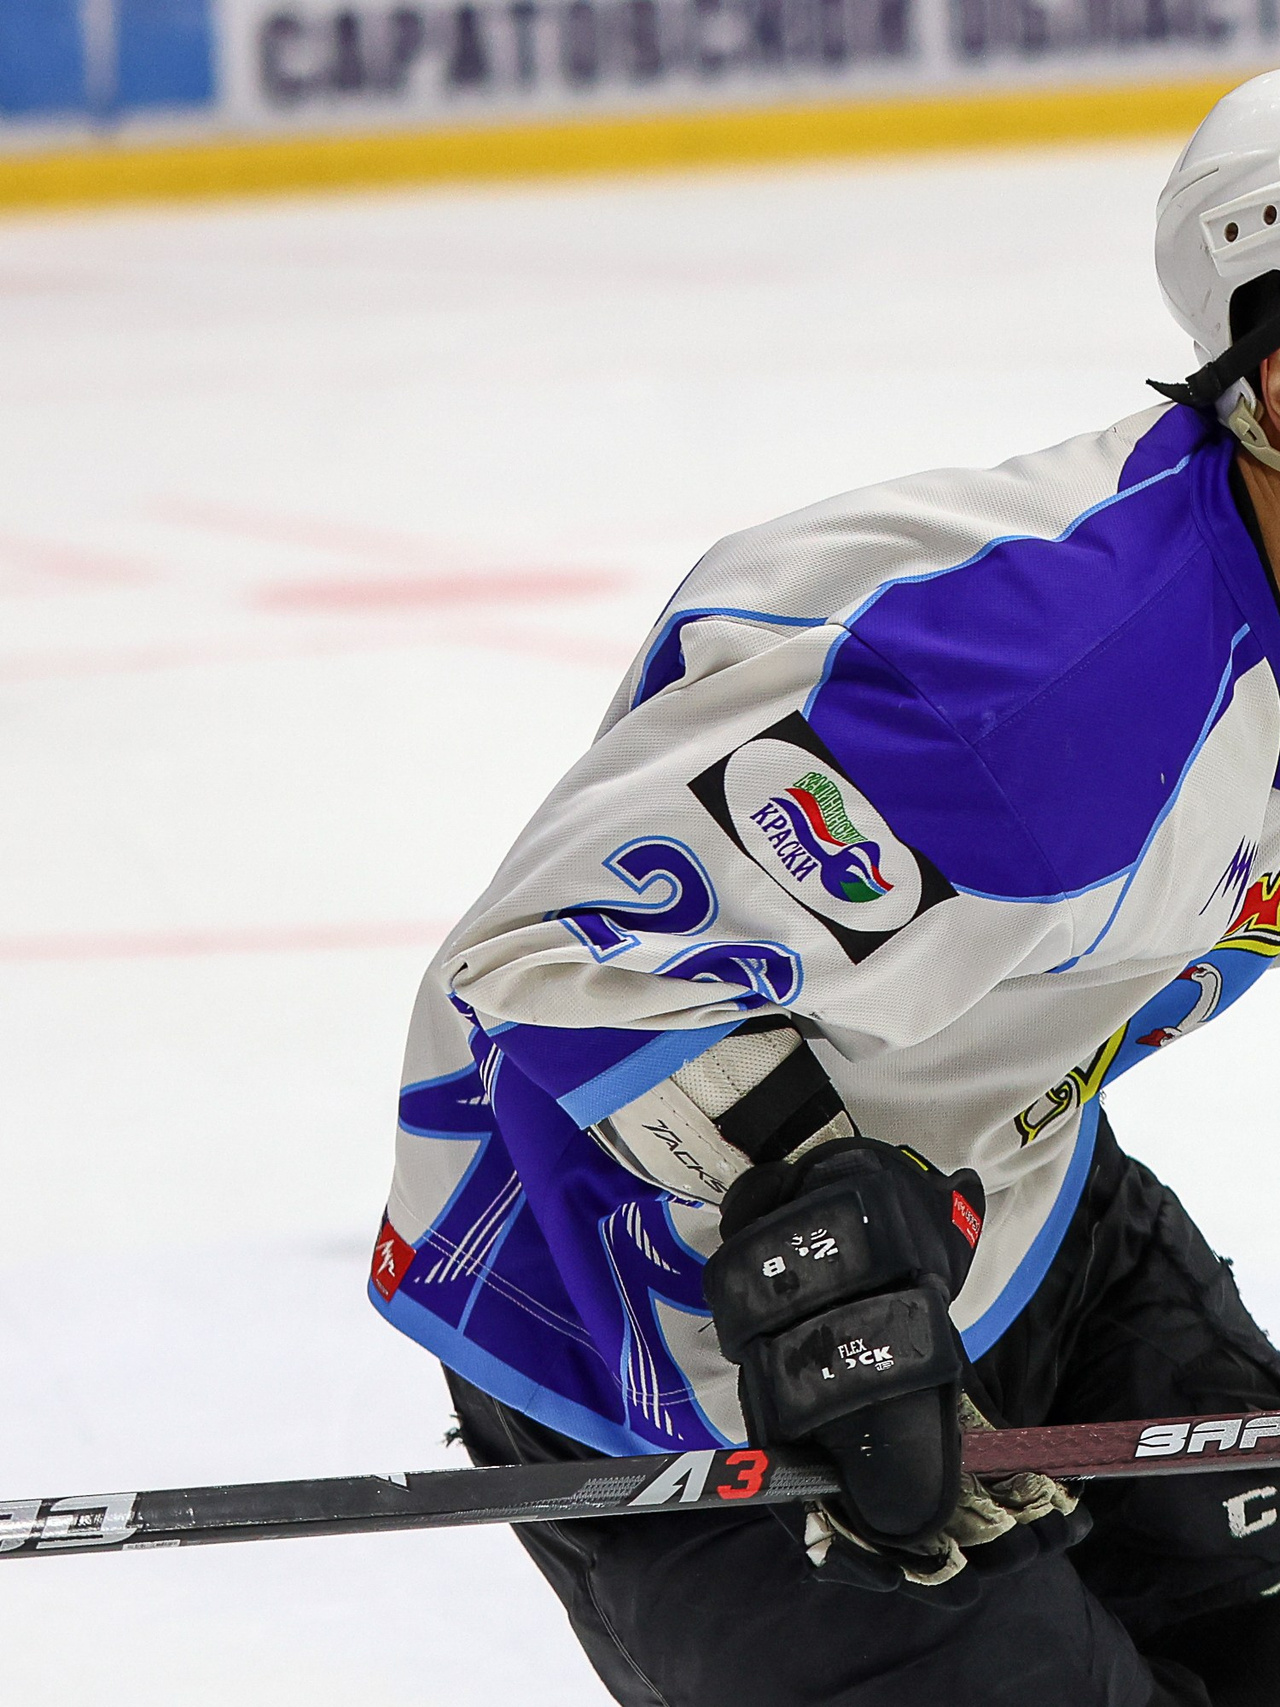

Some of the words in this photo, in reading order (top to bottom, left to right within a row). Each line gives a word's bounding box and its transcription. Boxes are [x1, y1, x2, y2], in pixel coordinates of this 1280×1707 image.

[750, 802, 819, 882] КРАСКИ
[641, 1118, 729, 1194] TACKS
[837, 1338, 868, 1359] FLEX
[627, 1448, 769, 1507] A3
